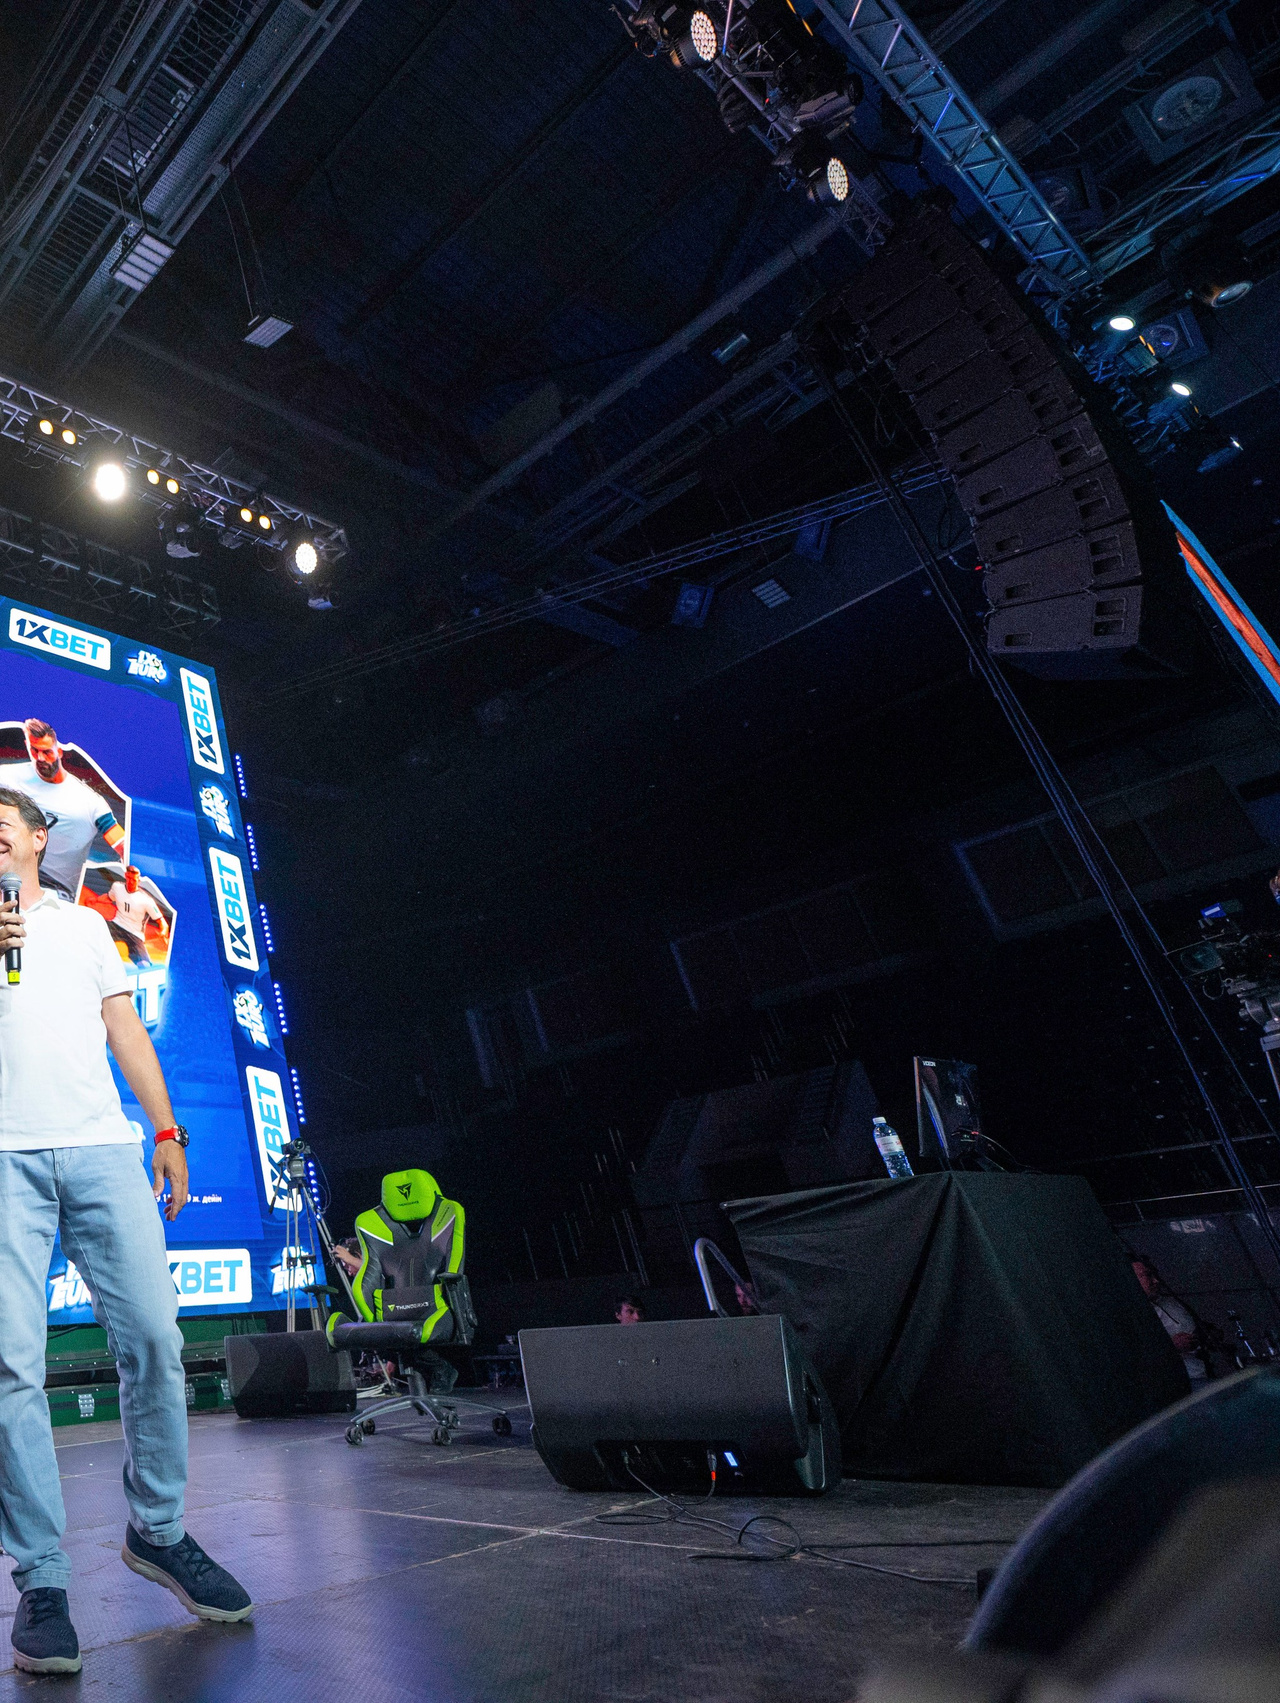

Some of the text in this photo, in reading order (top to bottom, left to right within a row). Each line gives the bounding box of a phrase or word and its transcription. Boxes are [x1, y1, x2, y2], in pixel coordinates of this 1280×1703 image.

[17, 617, 104, 660] 1XBET
[187, 676, 218, 765] 1XBET
[217, 856, 252, 961] 1XBET
